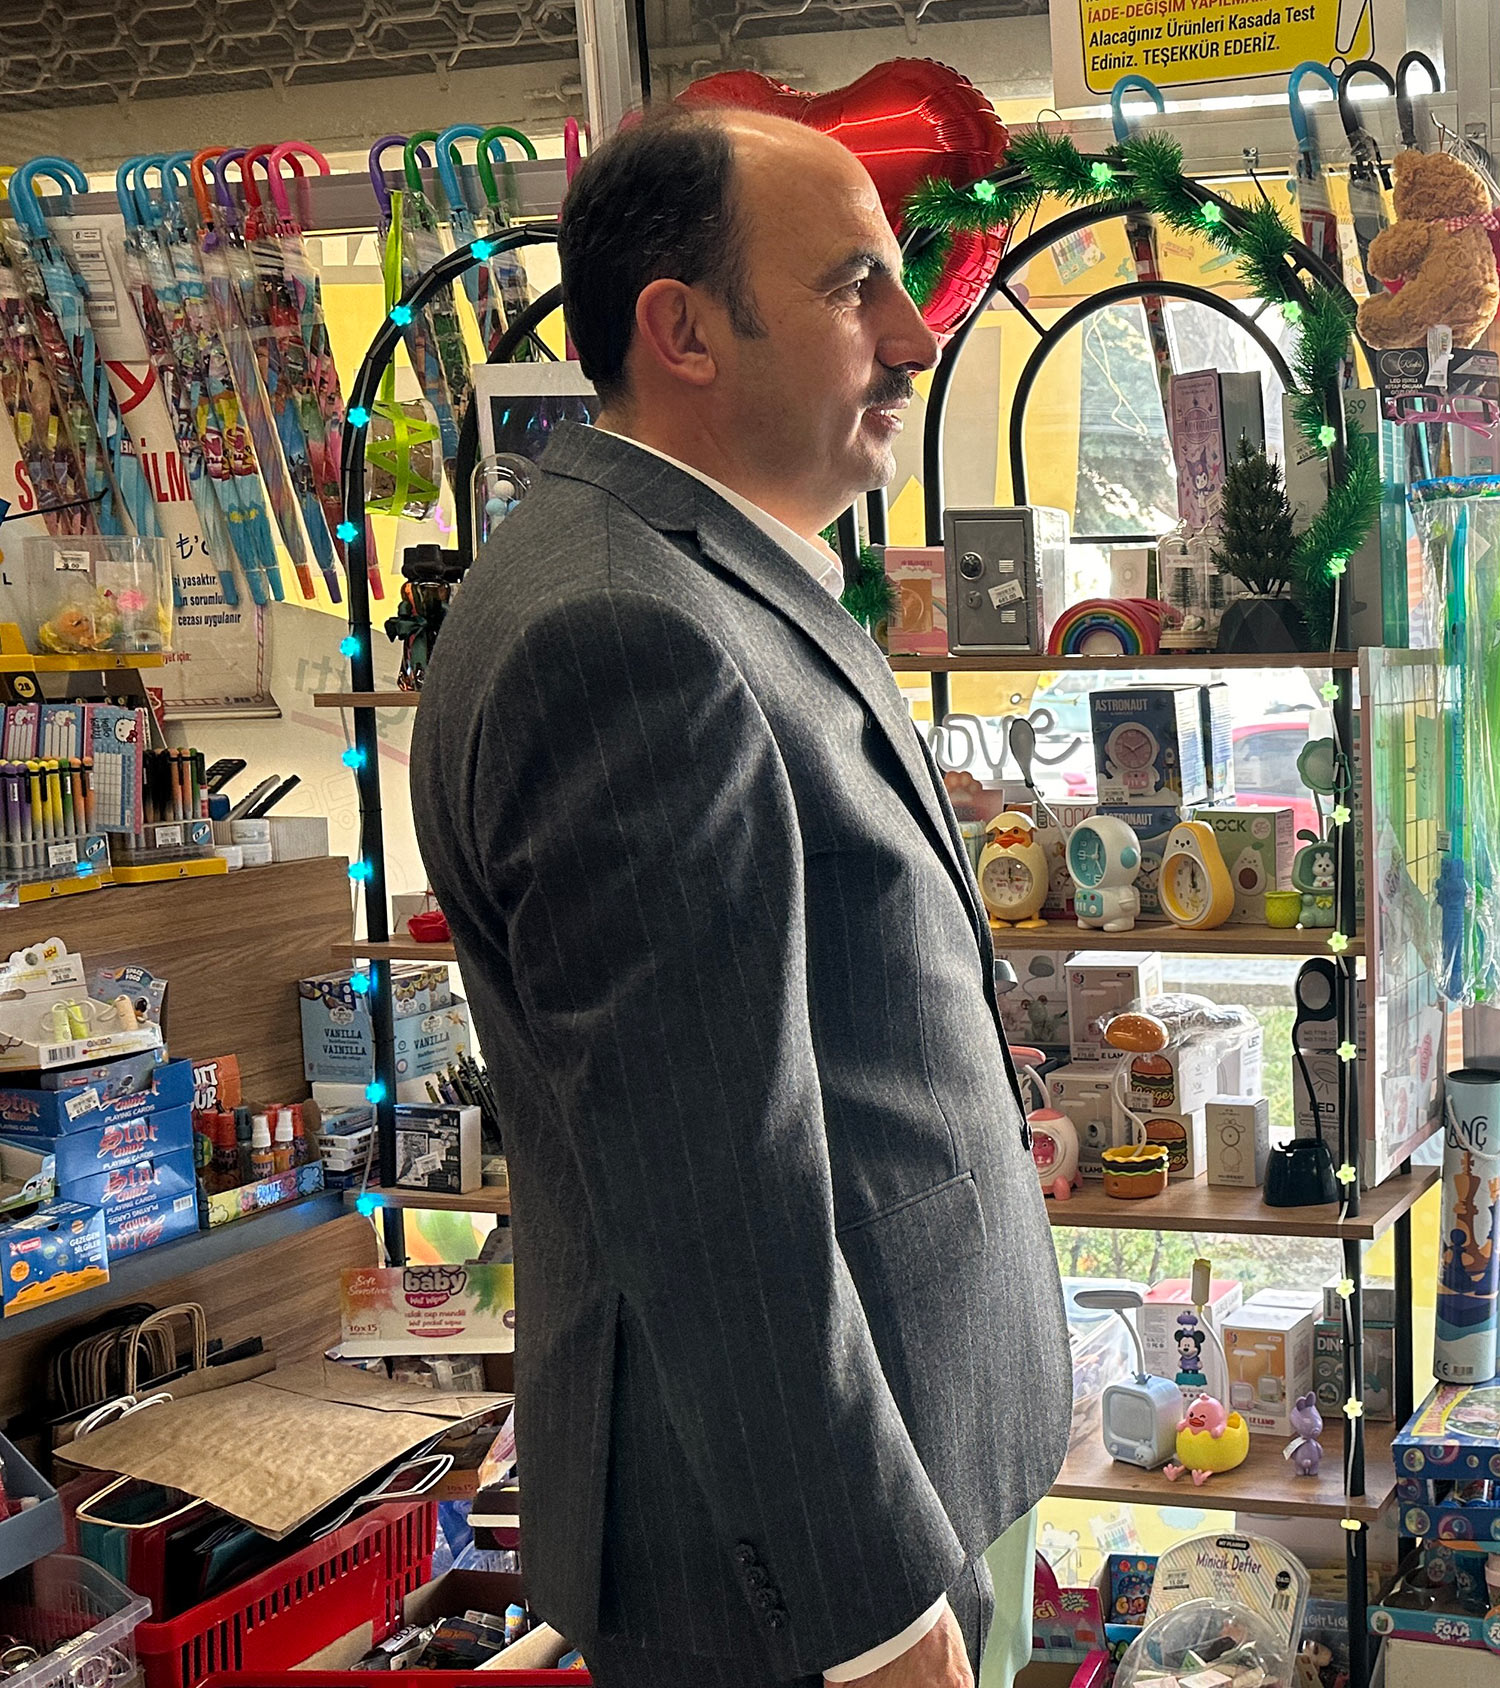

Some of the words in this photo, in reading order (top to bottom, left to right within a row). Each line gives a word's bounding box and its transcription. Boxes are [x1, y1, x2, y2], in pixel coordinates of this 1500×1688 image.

[1088, 2, 1185, 23] İADE-DEĞİŞİM
[1089, 26, 1162, 47] Alacağınız
[1167, 16, 1224, 37] Ürünleri
[1229, 9, 1281, 30] Kasada
[1285, 5, 1315, 22] Test
[1091, 51, 1138, 72] Ediniz.
[1143, 40, 1220, 68] TEŞEKKÜR
[1224, 32, 1280, 56] EDERİZ.
[178, 615, 202, 626] cezası
[1095, 698, 1148, 712] ASTRONAUT
[325, 1028, 363, 1040] VANILLA
[414, 1032, 450, 1050] VANILLA
[323, 1044, 367, 1056] VAINILLA
[104, 1111, 132, 1123] PLAYING
[133, 1104, 155, 1117] CARDS
[103, 1157, 131, 1170] PLAYING
[106, 1202, 134, 1215] PLAYING
[135, 1194, 157, 1207] CARDS
[355, 1275, 376, 1287] Soft
[403, 1271, 467, 1296] baby
[1196, 1554, 1229, 1569] Minicik
[1232, 1555, 1262, 1574] Defter
[1434, 1624, 1471, 1637] FOAM
